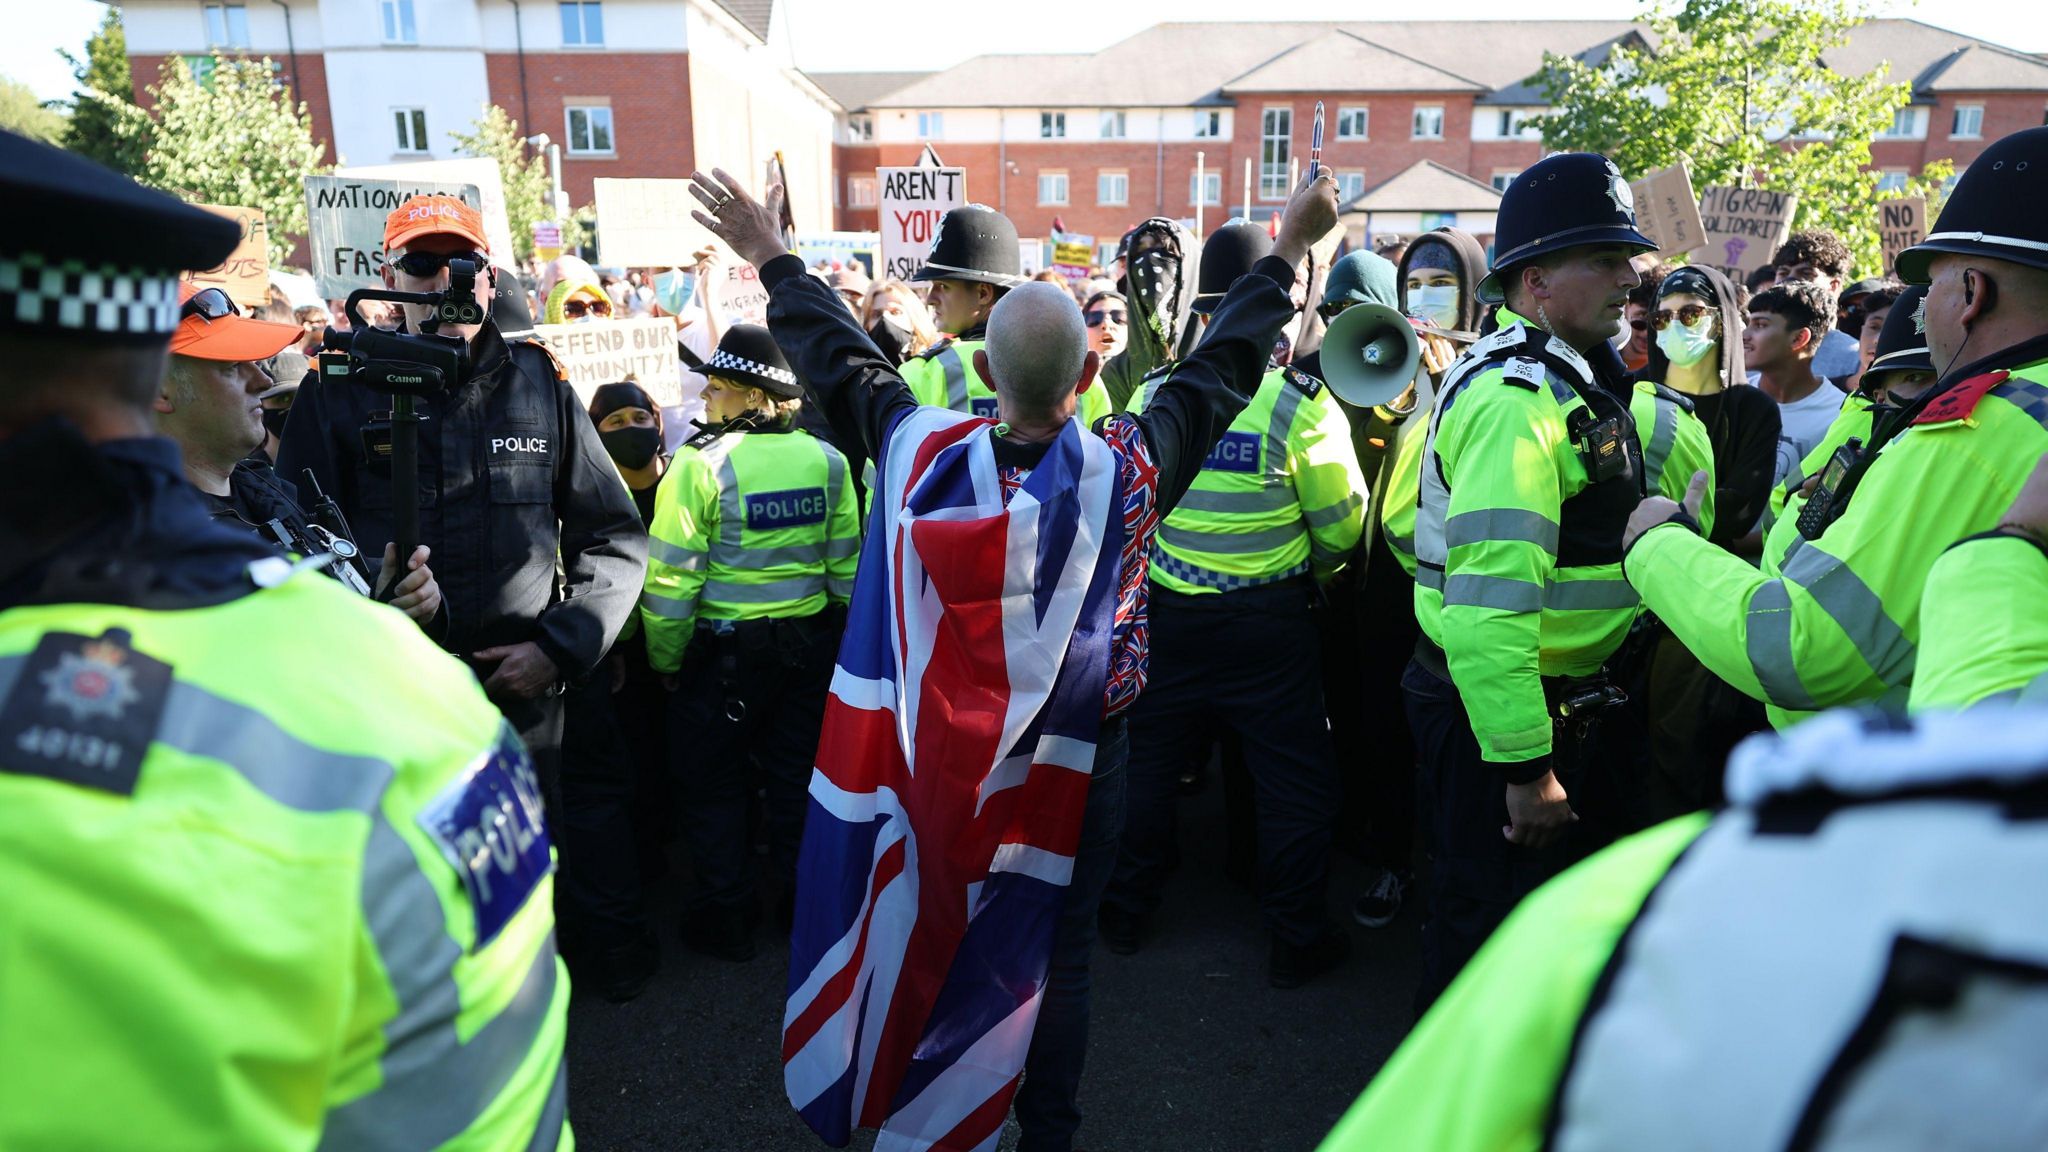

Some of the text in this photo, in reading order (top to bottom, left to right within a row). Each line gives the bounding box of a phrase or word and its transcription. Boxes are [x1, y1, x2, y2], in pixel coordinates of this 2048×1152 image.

[884, 170, 961, 201] AREN'T
[409, 205, 462, 221] POLICE
[1884, 204, 1914, 228] NO
[551, 325, 674, 357] EFEND OUR
[1517, 364, 1533, 373] CC
[386, 374, 422, 384] Canon
[491, 437, 548, 454] POLICE
[751, 496, 824, 521] POLICE
